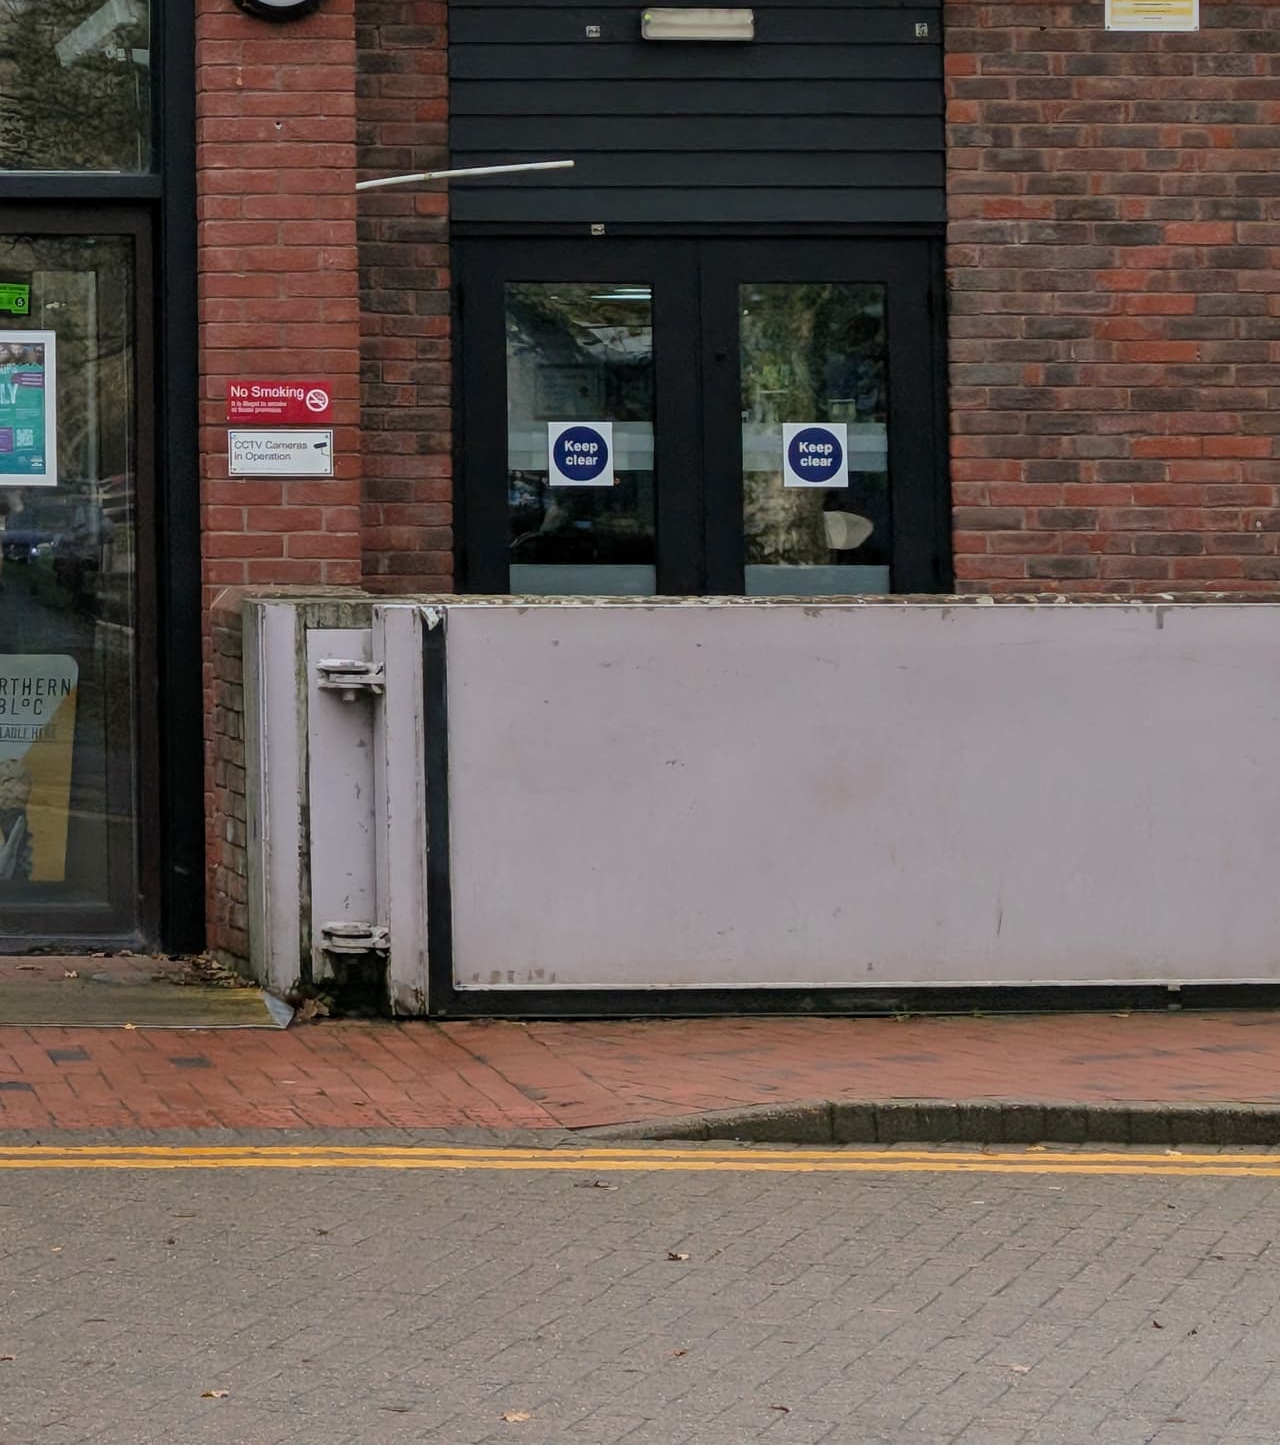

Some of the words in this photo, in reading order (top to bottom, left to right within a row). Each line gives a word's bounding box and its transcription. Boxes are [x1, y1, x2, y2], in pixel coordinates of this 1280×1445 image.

[230, 385, 249, 398] No
[251, 385, 305, 401] Smoking
[234, 440, 262, 450] CCTV
[265, 440, 308, 450] Cameras
[564, 440, 598, 455] Keep
[798, 441, 833, 457] Keep
[245, 451, 292, 462] Operation
[565, 454, 598, 466] clear
[800, 455, 833, 468] clear
